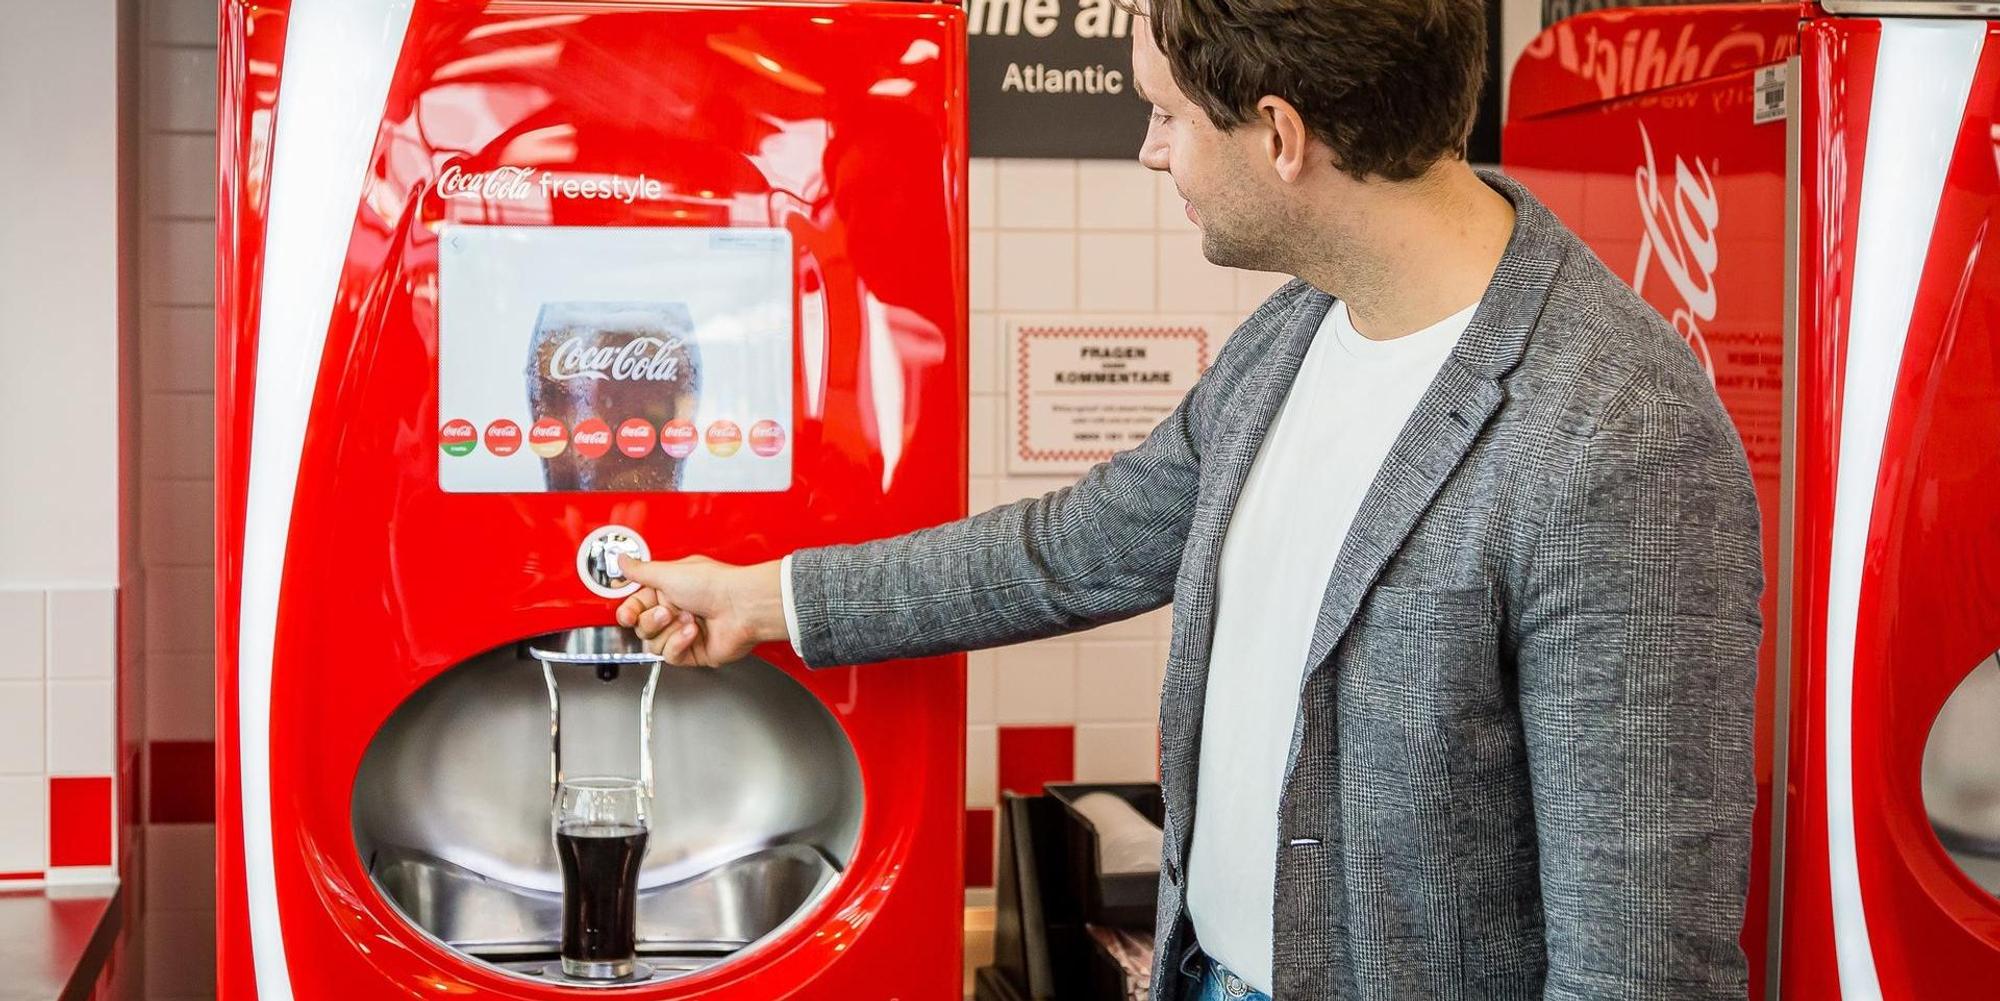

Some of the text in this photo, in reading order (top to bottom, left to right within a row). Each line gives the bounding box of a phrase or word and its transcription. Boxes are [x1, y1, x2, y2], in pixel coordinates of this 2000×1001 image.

[1001, 62, 1123, 94] Atlantic
[539, 171, 662, 204] freestyle
[550, 336, 687, 381] Coca-Cola
[1080, 346, 1146, 358] FRAGEN
[1055, 371, 1171, 383] KOMMENTARE
